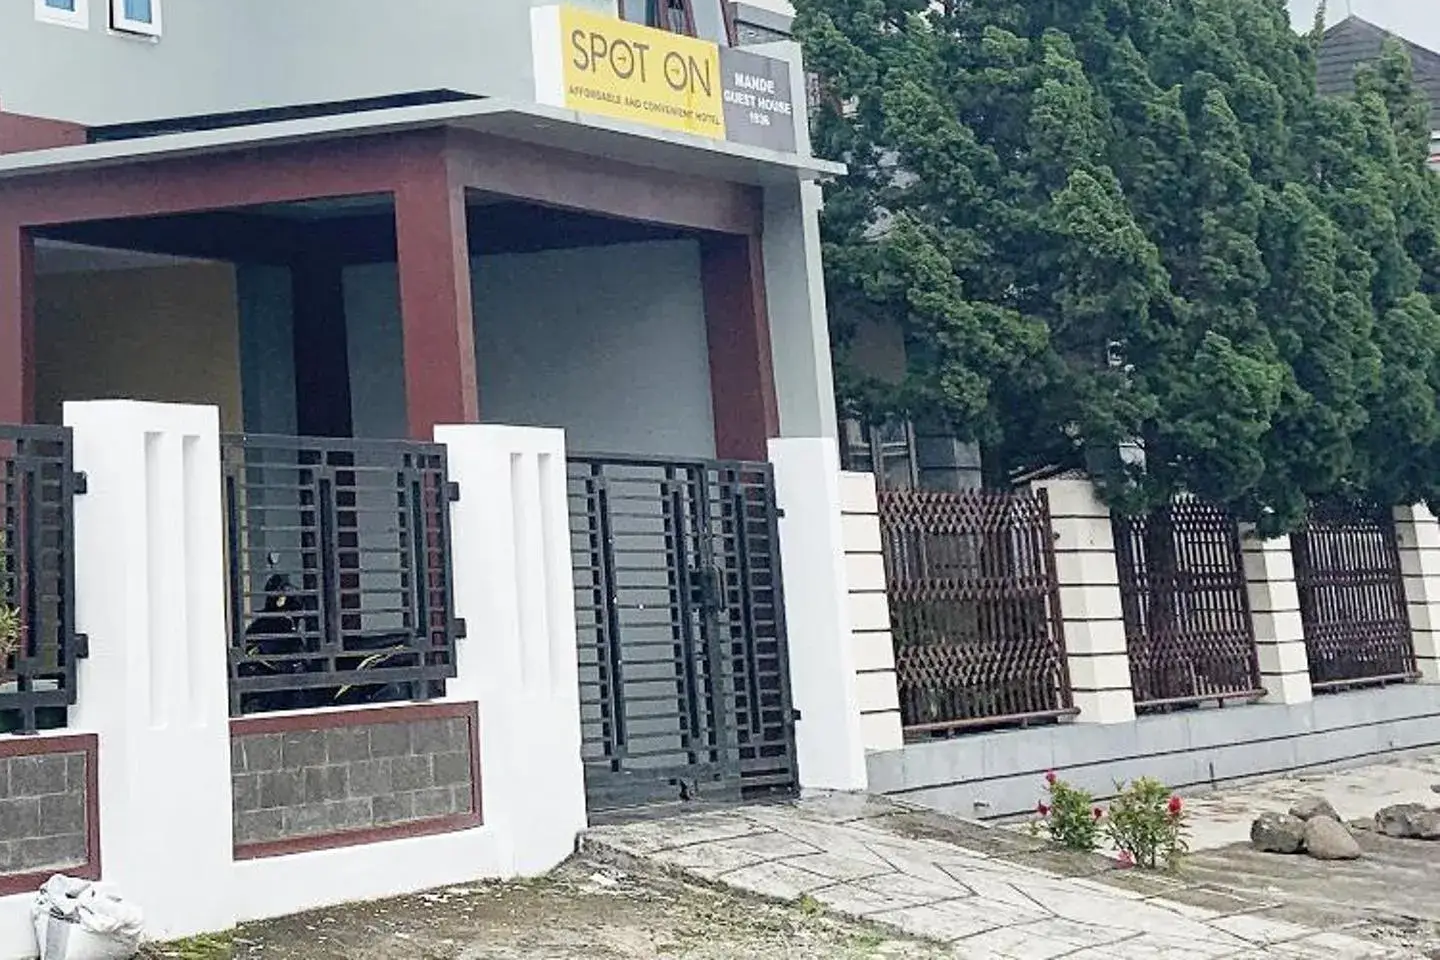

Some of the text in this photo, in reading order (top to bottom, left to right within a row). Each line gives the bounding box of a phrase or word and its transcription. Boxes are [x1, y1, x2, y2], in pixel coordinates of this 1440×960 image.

[571, 29, 711, 97] SPOT ON
[734, 72, 775, 94] MANDE
[569, 85, 720, 125] AFFORDABLE AND CONVENIENT HOTEL
[724, 90, 791, 114] GUEST HOUSE
